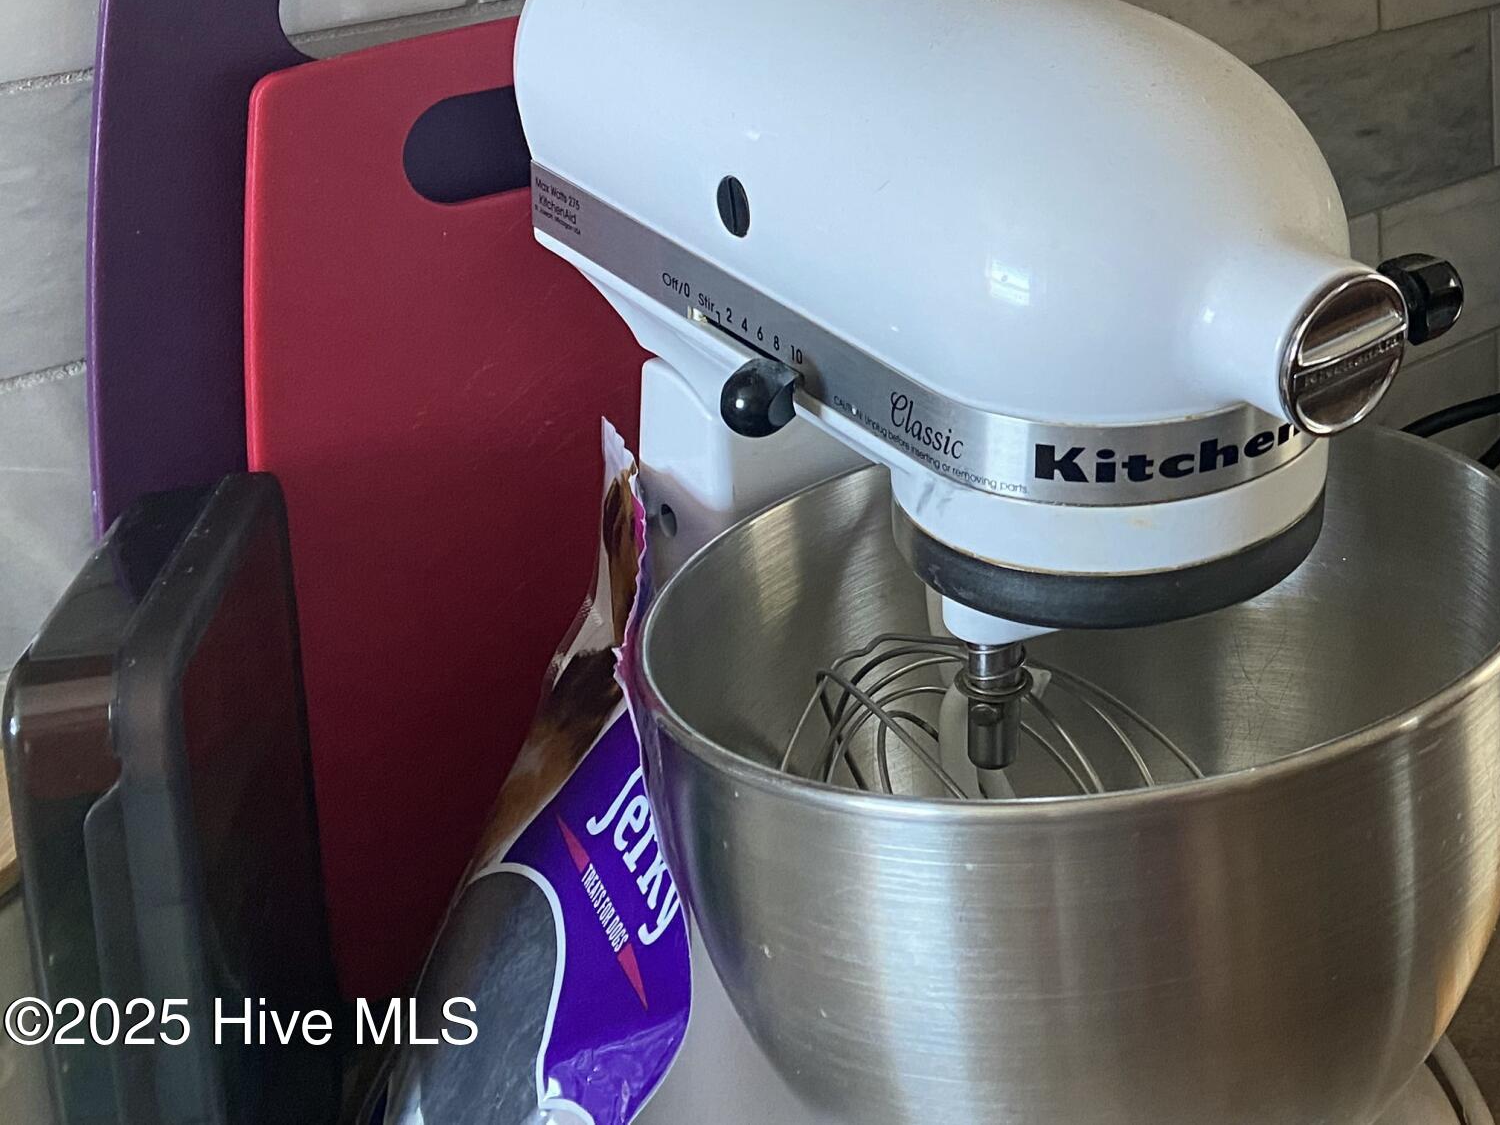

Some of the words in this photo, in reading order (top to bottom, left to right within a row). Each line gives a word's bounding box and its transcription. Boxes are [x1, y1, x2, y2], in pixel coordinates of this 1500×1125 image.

[538, 194, 577, 225] KitchenAid
[698, 292, 716, 312] Stir
[716, 311, 721, 324] 1
[726, 308, 733, 323] 2
[741, 317, 748, 332] 4
[757, 326, 764, 341] 6
[773, 335, 780, 351] 8
[791, 345, 803, 364] 10
[890, 391, 964, 460] Classic
[888, 430, 910, 452] before
[911, 446, 940, 471] inserting
[941, 463, 951, 472] or
[953, 466, 998, 490] removing
[999, 481, 1029, 496] parts.
[586, 765, 681, 946] Jerky
[581, 862, 607, 910] TREATS
[596, 896, 614, 928] FOR
[605, 914, 630, 953] DOGS
